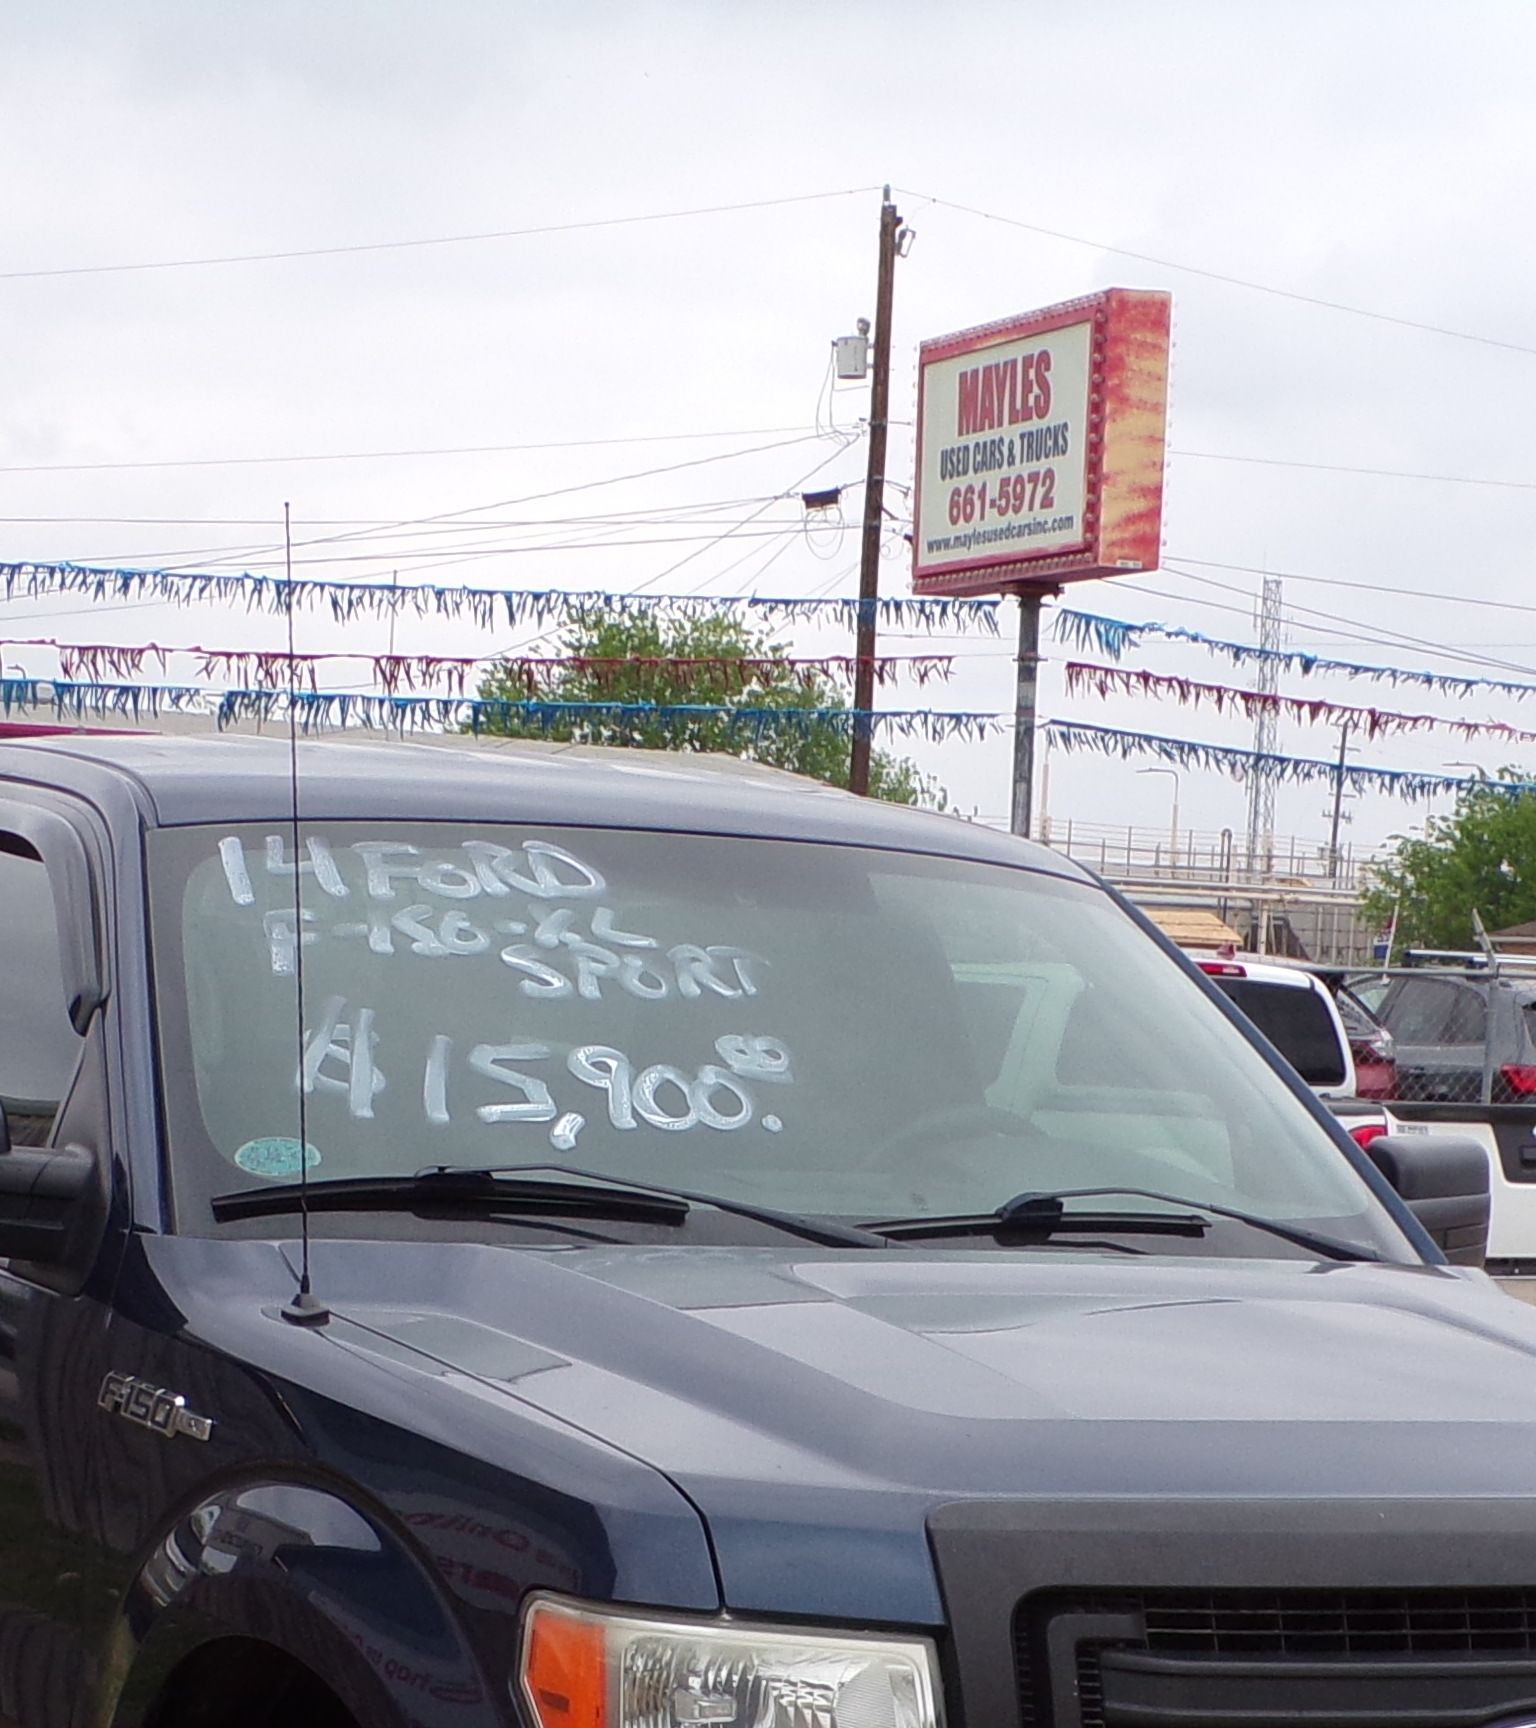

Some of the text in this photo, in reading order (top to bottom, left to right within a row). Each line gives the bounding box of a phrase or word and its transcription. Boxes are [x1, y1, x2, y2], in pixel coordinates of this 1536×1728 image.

[957, 348, 1053, 438] MAYLES
[939, 421, 1069, 482] USED CARS & TRUCKS
[948, 467, 1056, 527] 661-5972
[926, 514, 1075, 552] www.maylesusedcarsinc.com
[217, 836, 351, 905] 14
[500, 943, 771, 1000] SPORT
